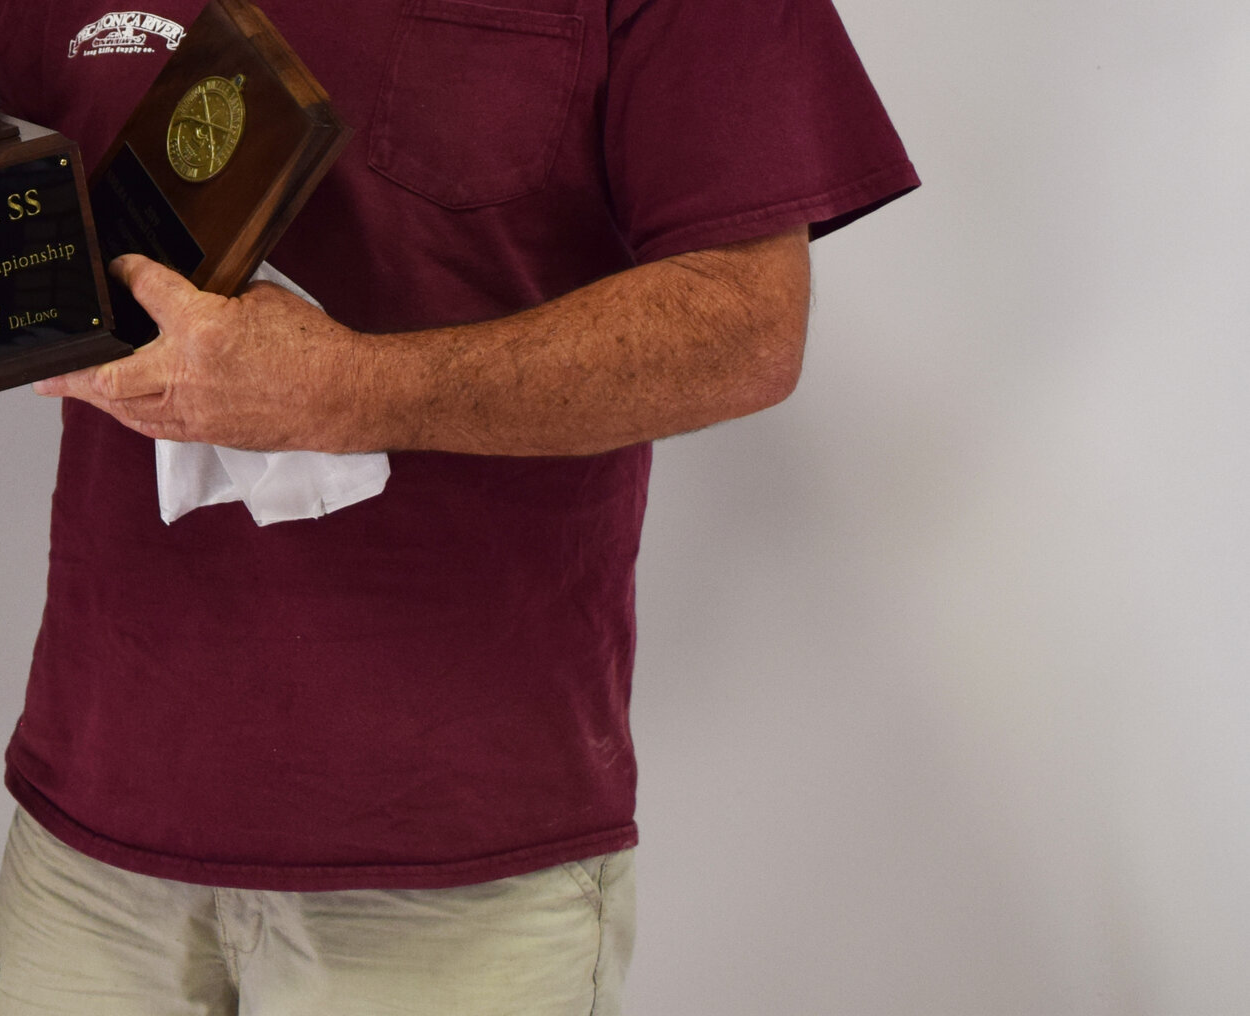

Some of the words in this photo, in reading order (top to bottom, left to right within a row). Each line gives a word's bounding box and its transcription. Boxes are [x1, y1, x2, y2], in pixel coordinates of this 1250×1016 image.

[141, 15, 180, 41] RIVER
[116, 45, 142, 54] Supply
[7, 189, 41, 221] SS
